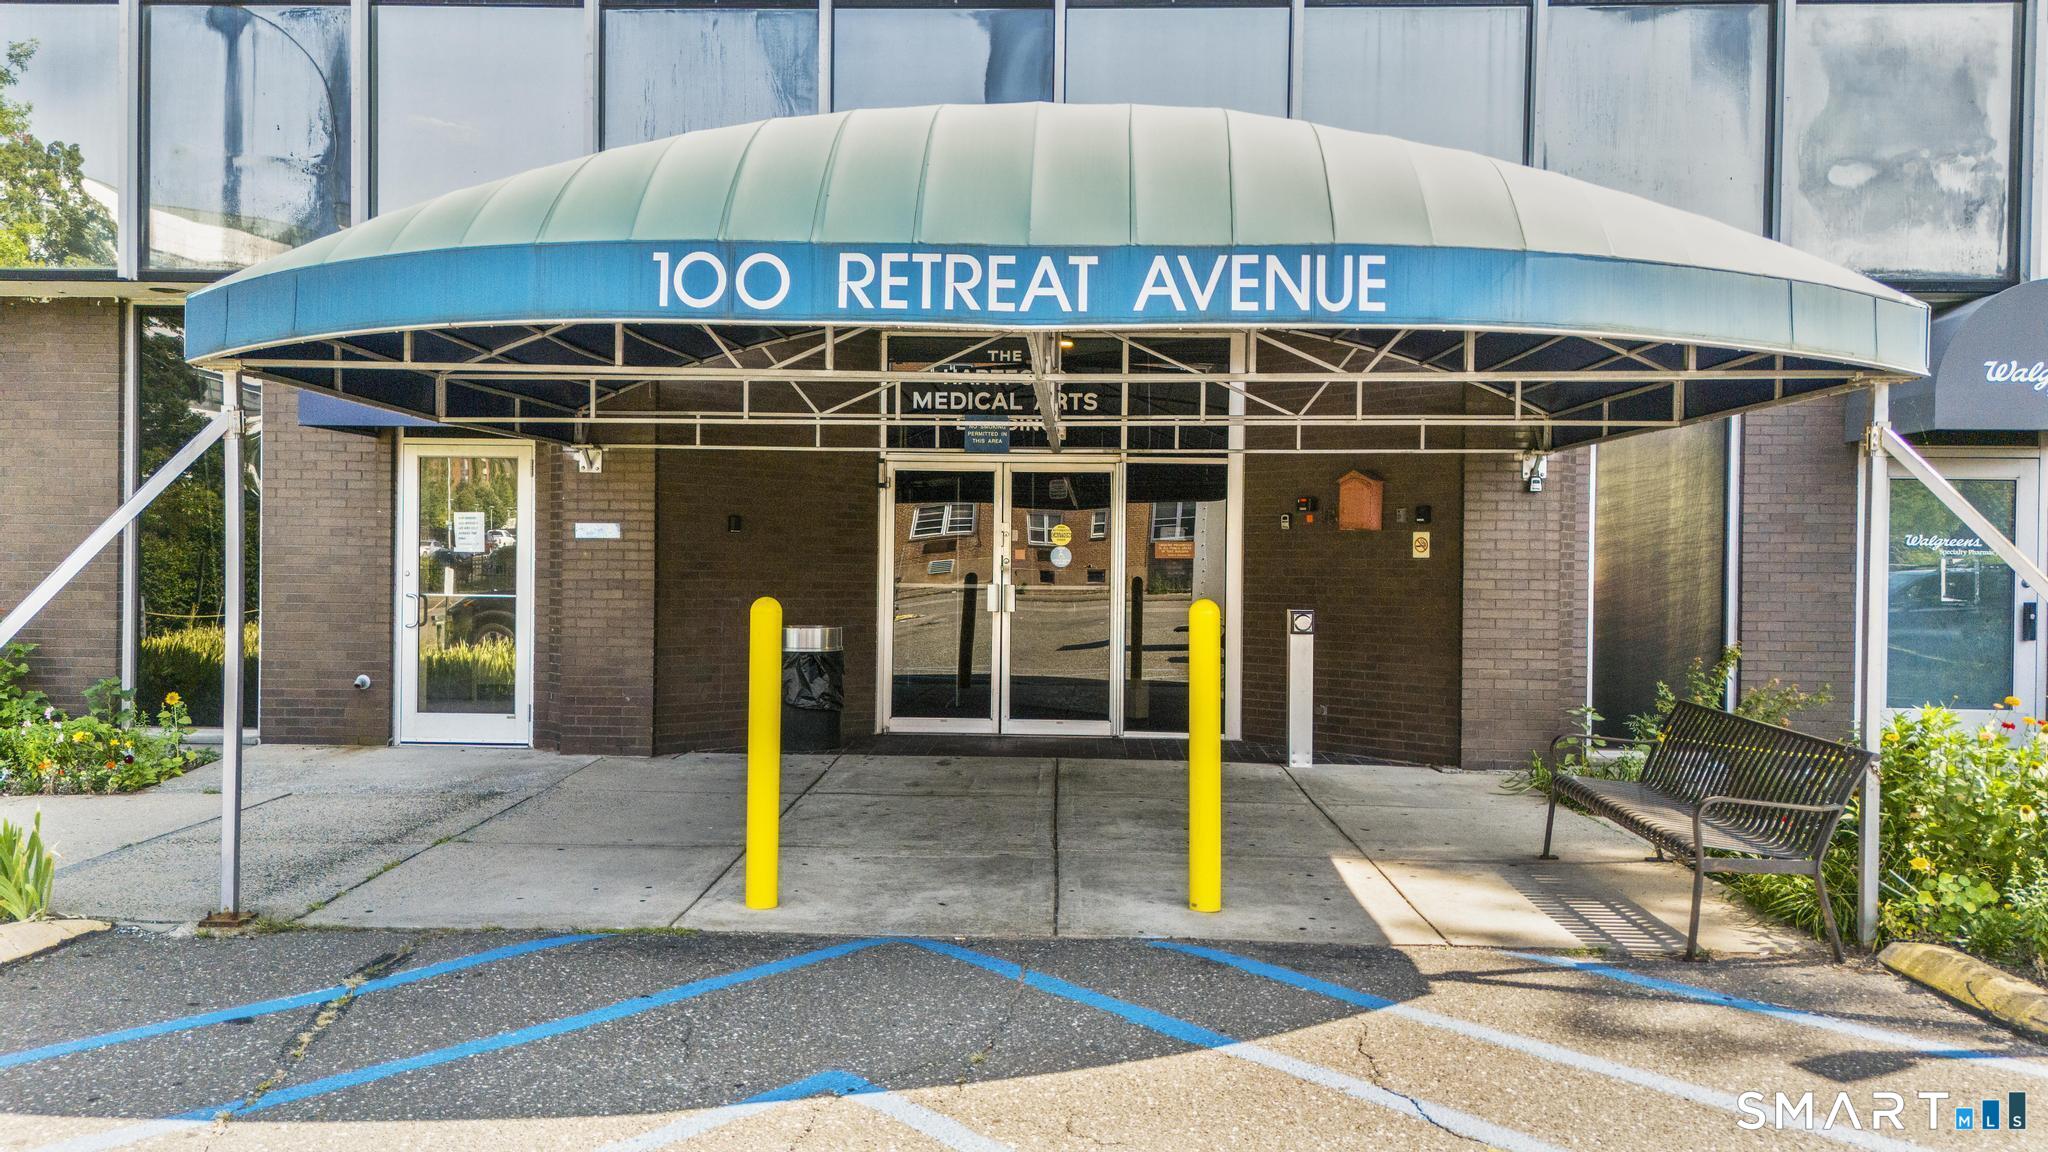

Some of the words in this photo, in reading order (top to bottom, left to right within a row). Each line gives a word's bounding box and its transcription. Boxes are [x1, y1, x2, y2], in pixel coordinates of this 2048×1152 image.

[651, 251, 791, 310] 100
[837, 252, 1099, 312] RETREAT
[1132, 254, 1387, 312] AVENUE
[987, 350, 1022, 362] THE
[912, 391, 1023, 410] MEDICAL
[1905, 534, 1983, 551] Walgreens
